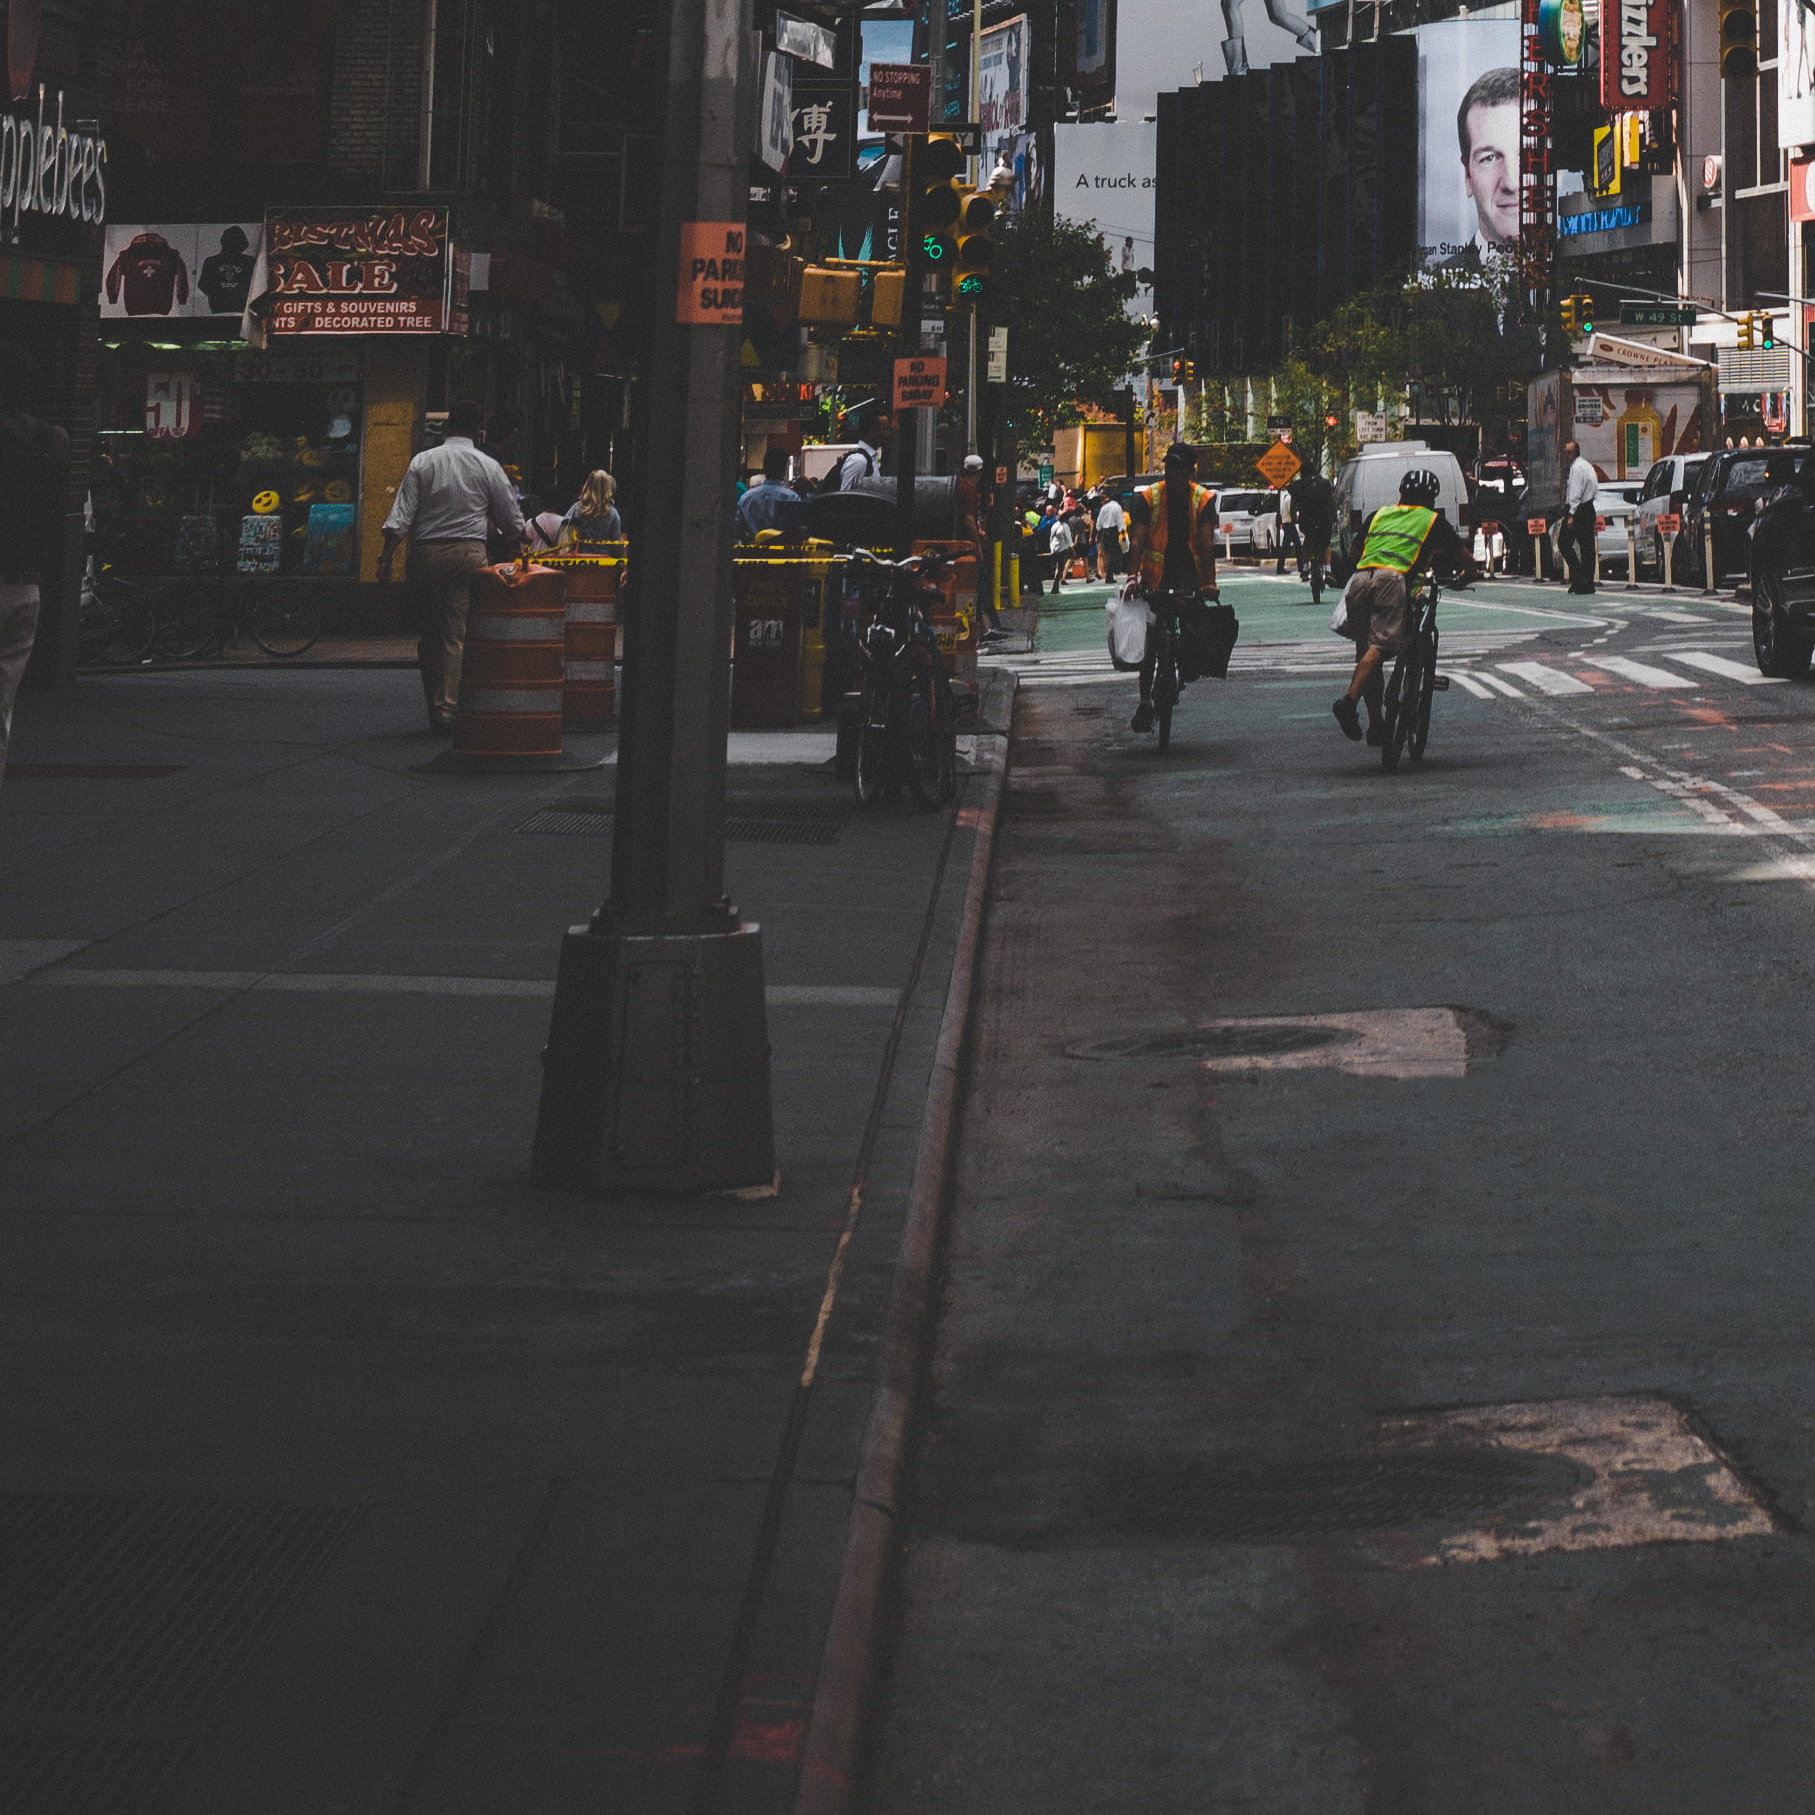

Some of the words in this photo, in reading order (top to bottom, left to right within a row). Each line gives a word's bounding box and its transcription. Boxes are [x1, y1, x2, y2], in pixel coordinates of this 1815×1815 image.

[873, 70, 883, 84] NO
[884, 71, 921, 86] STOPPING
[873, 88, 904, 100] Anytime
[1075, 173, 1089, 189] A
[1093, 172, 1135, 189] truck
[726, 232, 743, 254] NO
[284, 302, 322, 314] GIFTS
[326, 302, 336, 314] &
[340, 301, 417, 313] SOUVENIRS
[315, 316, 393, 328] DECORATED
[397, 316, 432, 328] TREE
[1634, 312, 1645, 322] W
[1649, 312, 1665, 323] 49
[1669, 312, 1682, 323] St
[1617, 347, 1649, 362] CROWNE
[910, 360, 925, 373] NO
